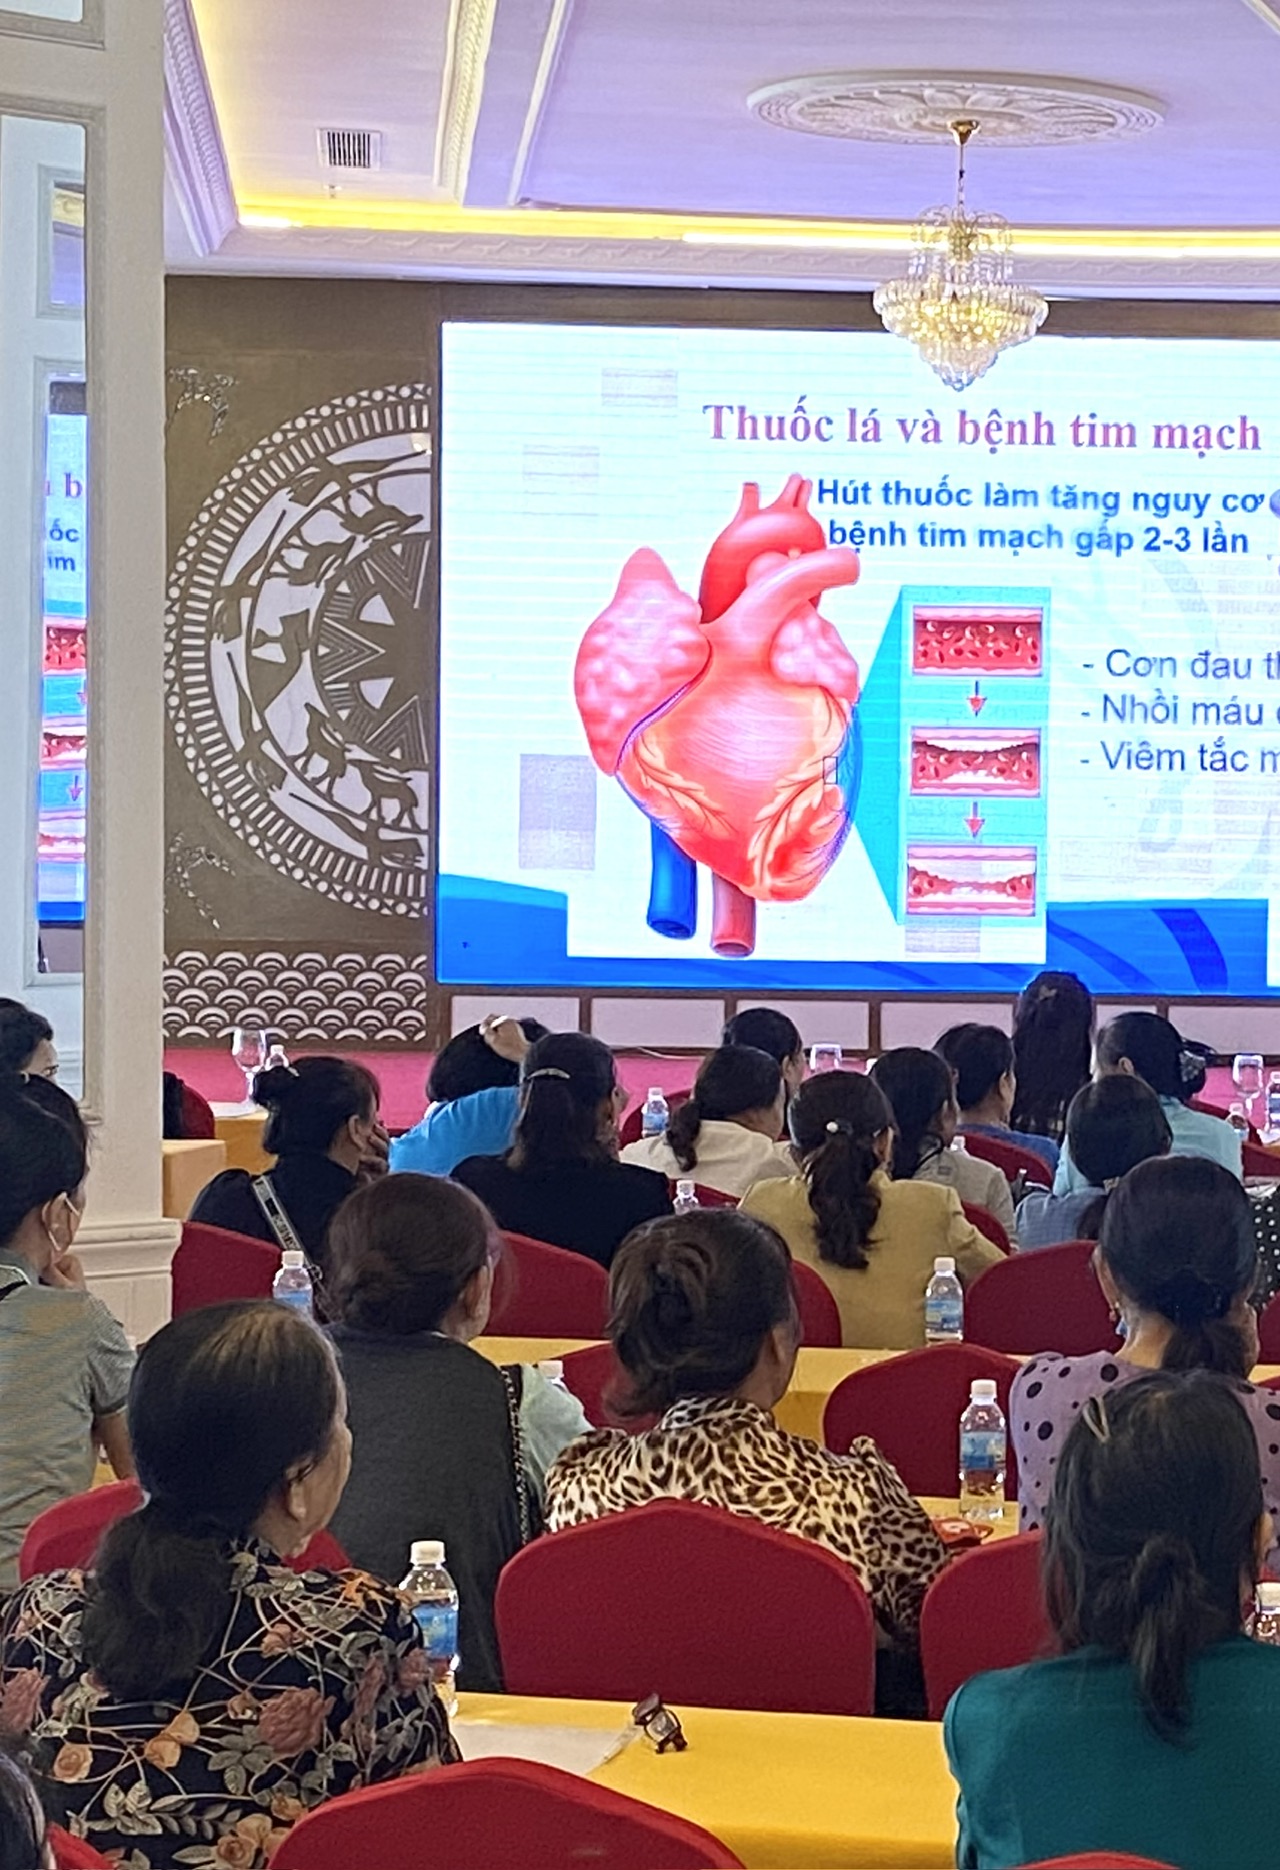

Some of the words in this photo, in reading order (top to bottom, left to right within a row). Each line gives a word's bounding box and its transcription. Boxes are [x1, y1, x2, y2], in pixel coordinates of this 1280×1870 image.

[702, 395, 834, 442] Thuốc
[847, 407, 882, 442] lá
[896, 408, 943, 444] và
[958, 408, 1056, 454] bệnh
[1070, 412, 1137, 448] tim
[1152, 415, 1262, 459] mạch
[817, 478, 872, 505] Hút
[882, 474, 973, 507] thuốc
[984, 481, 1039, 507] làm
[1051, 483, 1121, 518] tăng
[1132, 491, 1212, 519] nguy
[1222, 492, 1265, 513] cơ
[829, 518, 906, 554] bệnh
[917, 521, 967, 547] tim
[978, 523, 1064, 557] mạch
[1075, 519, 1135, 558] gấp
[1143, 526, 1192, 552] 2-3
[1202, 520, 1249, 553] lần
[1106, 648, 1177, 678] Cơn
[1190, 649, 1252, 679] đau
[1102, 688, 1179, 724] Nhồi
[1192, 695, 1264, 726] máu
[1100, 740, 1185, 771] Viêm
[1199, 736, 1249, 772] tắc
